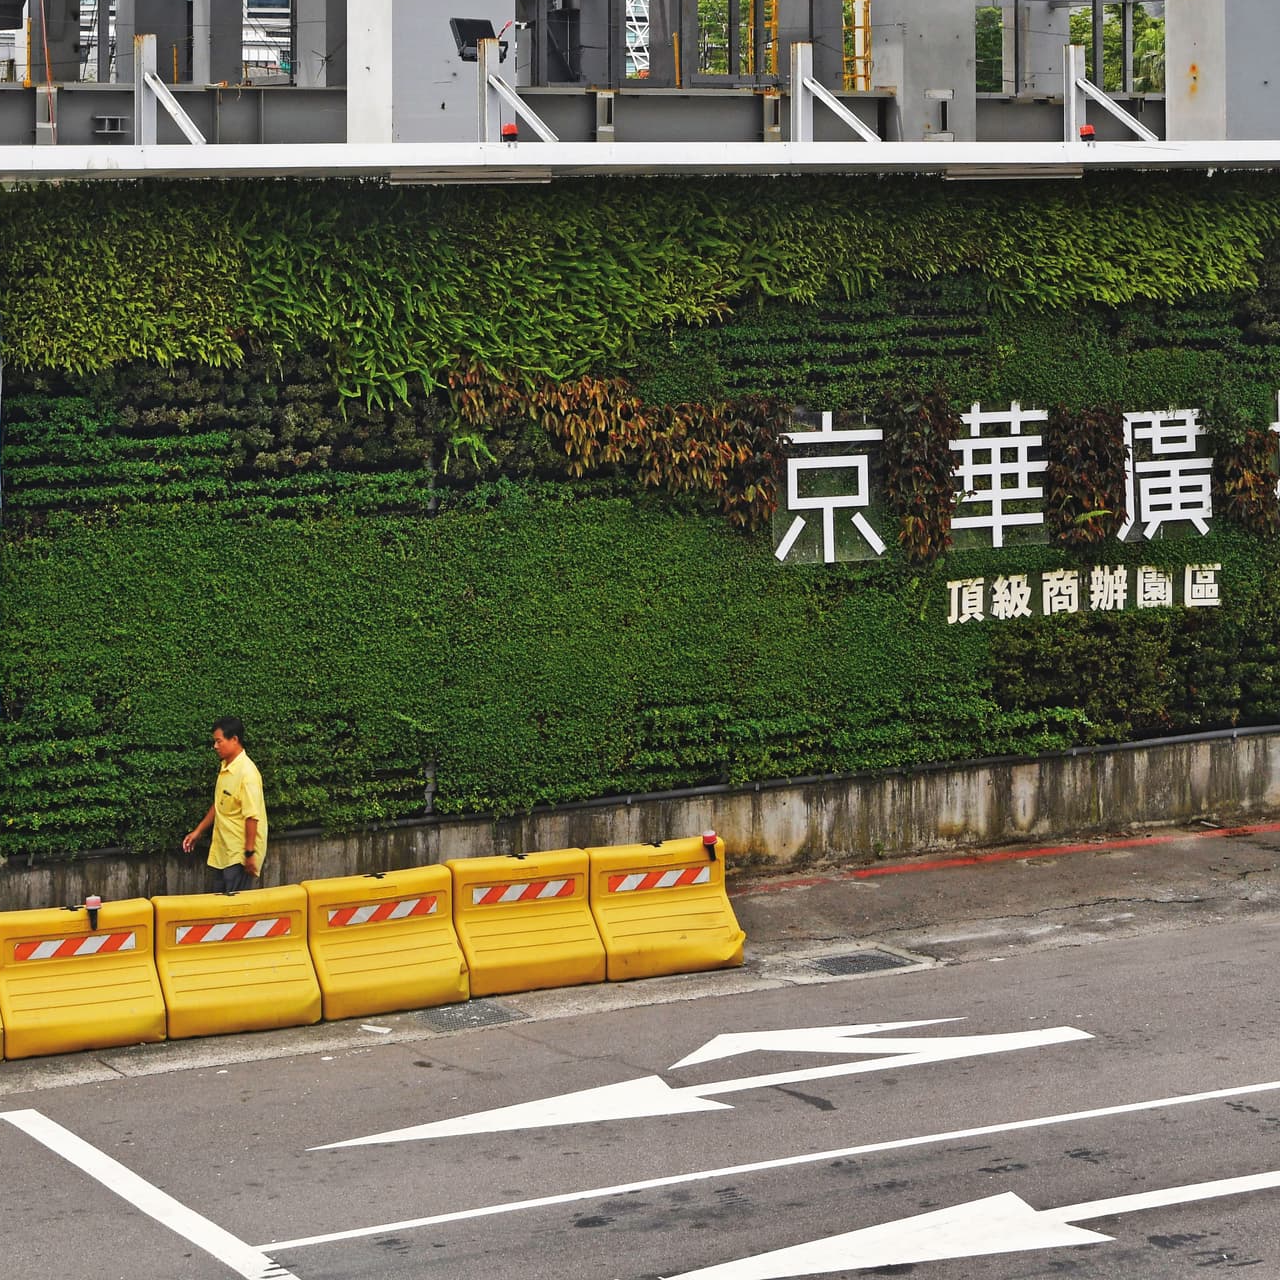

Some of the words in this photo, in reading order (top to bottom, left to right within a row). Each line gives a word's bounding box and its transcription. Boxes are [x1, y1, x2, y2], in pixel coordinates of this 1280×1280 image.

[946, 563, 1222, 625] 頂級商辦園區
